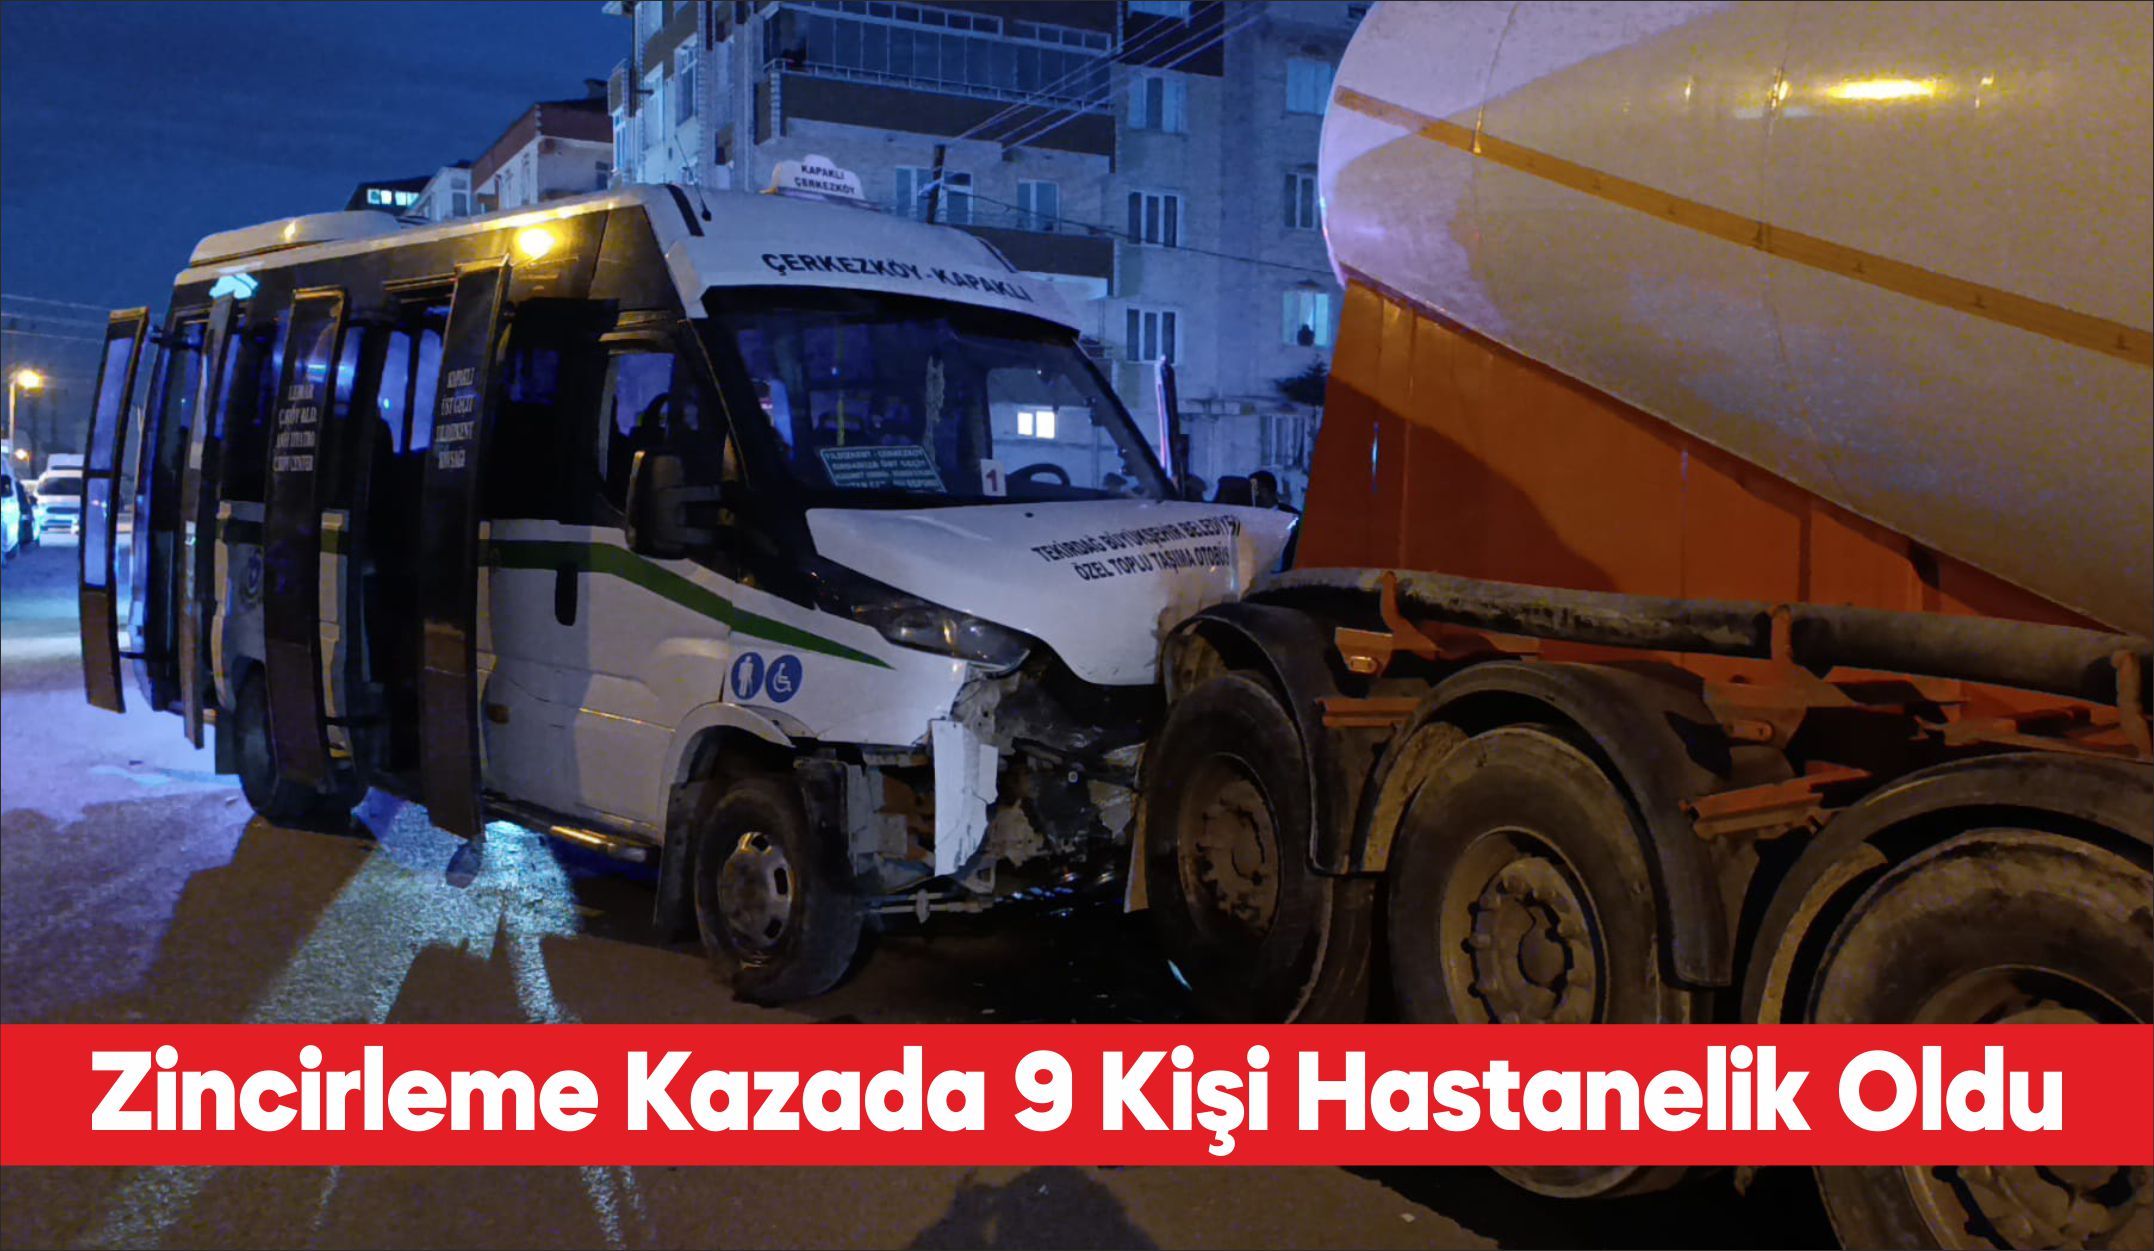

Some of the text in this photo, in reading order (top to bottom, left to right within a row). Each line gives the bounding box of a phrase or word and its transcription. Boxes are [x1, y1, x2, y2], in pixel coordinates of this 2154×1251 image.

[801, 165, 845, 180] KAPAKLI
[986, 469, 998, 492] 1
[1030, 534, 1107, 562] TEKİRDAĞ
[1070, 562, 1115, 581] ÖZEL
[1108, 554, 1154, 575] TOPLU
[1149, 547, 1198, 574] TAŞIMA
